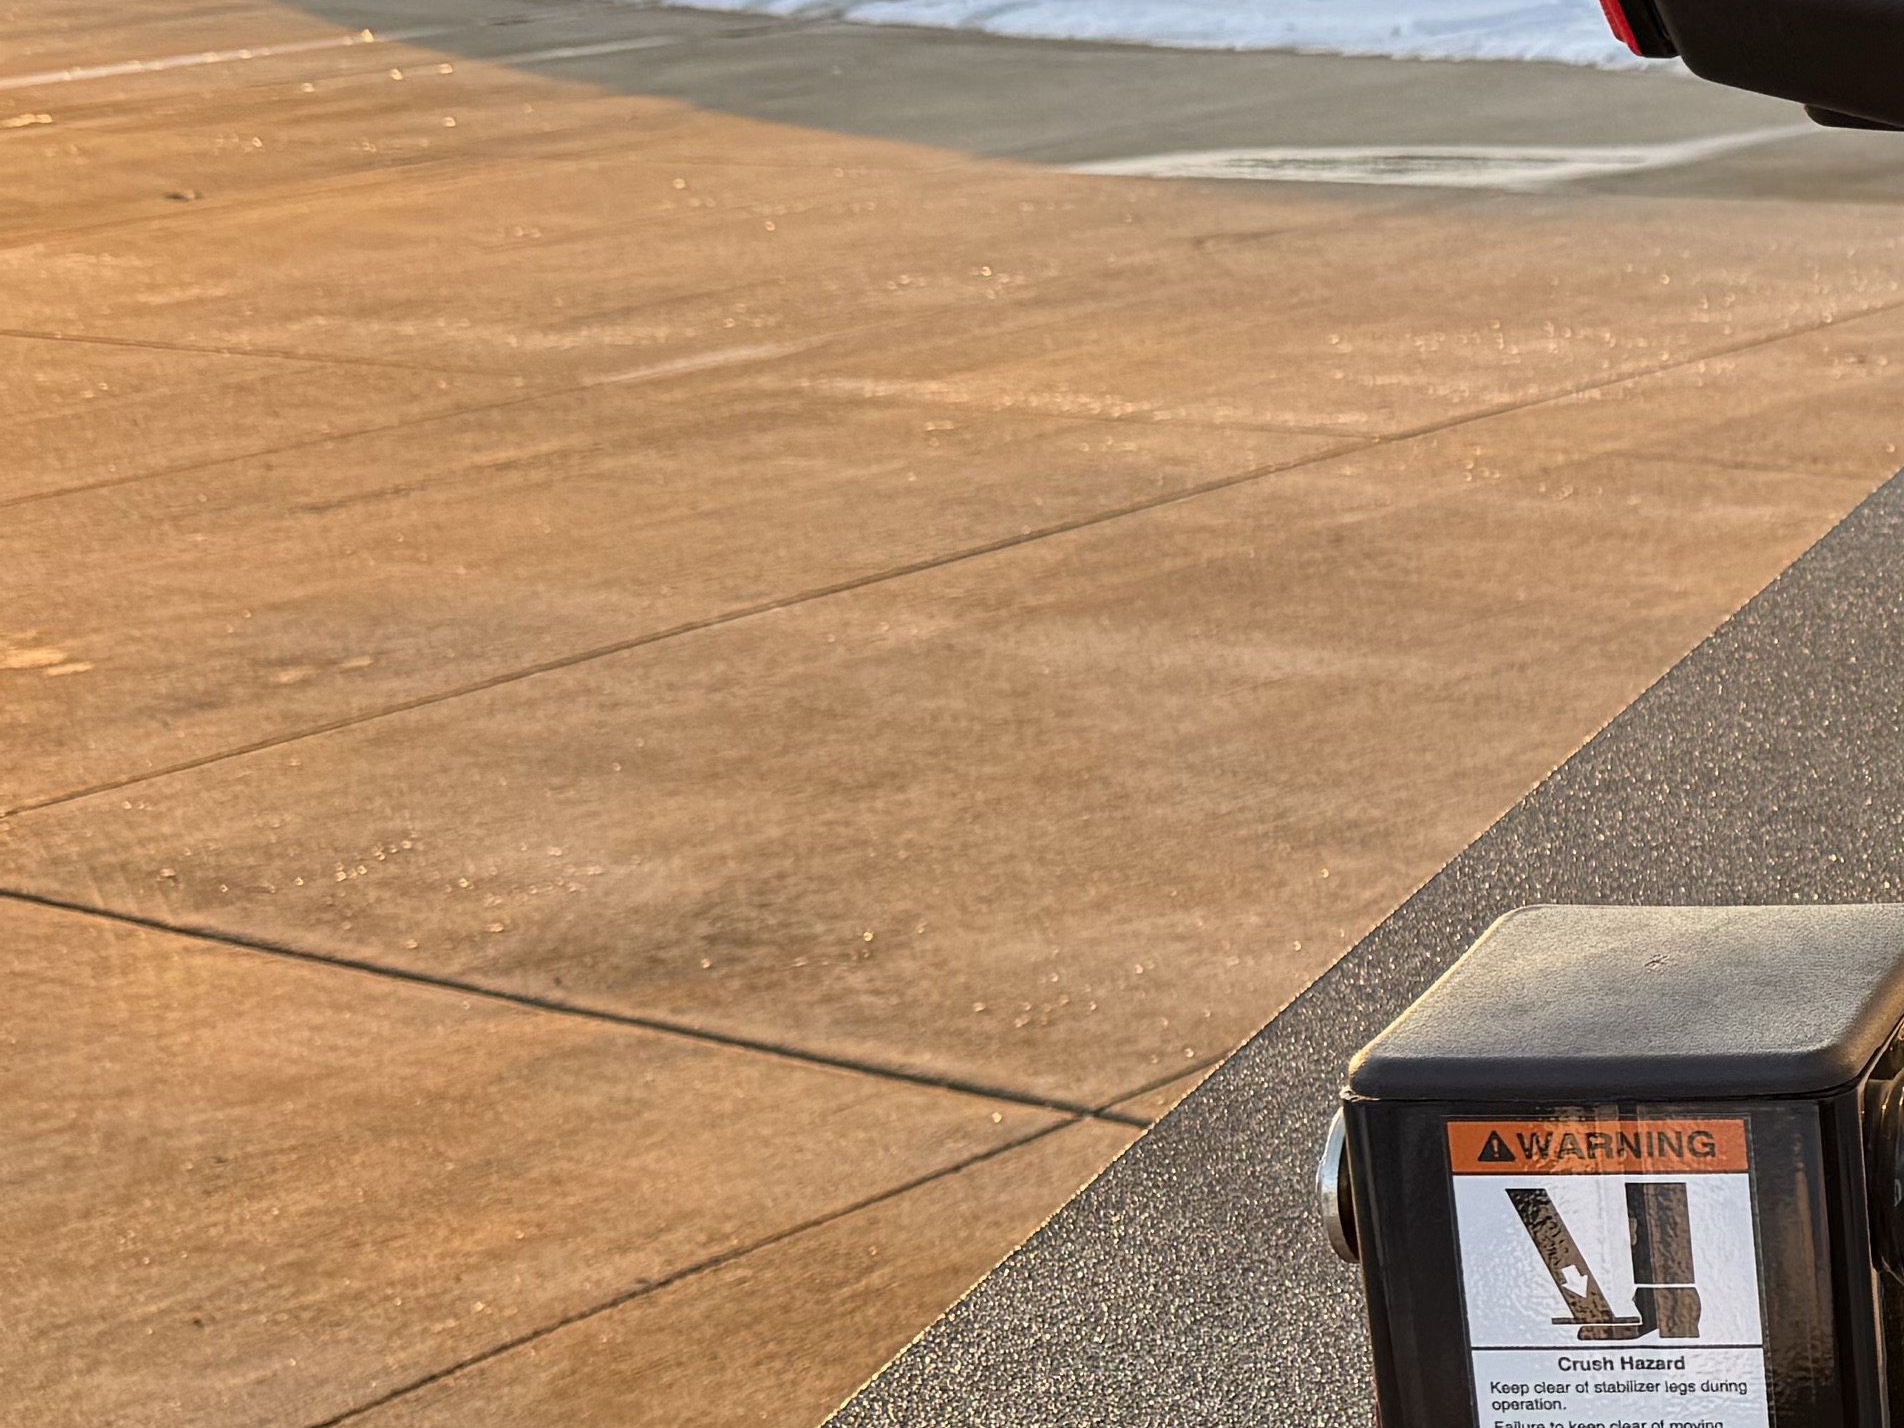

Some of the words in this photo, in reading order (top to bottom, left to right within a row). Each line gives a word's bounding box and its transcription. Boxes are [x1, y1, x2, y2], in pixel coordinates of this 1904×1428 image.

[1516, 1130, 1717, 1160] WARNING
[1558, 1356, 1614, 1372] Crush
[1620, 1356, 1685, 1371] Hazard
[1490, 1381, 1529, 1396] Keep
[1534, 1380, 1572, 1395] clear
[1575, 1380, 1590, 1394] of
[1594, 1379, 1660, 1394] stabilizer
[1664, 1379, 1696, 1395] legs
[1700, 1379, 1748, 1395] during
[1491, 1397, 1566, 1414] operation.
